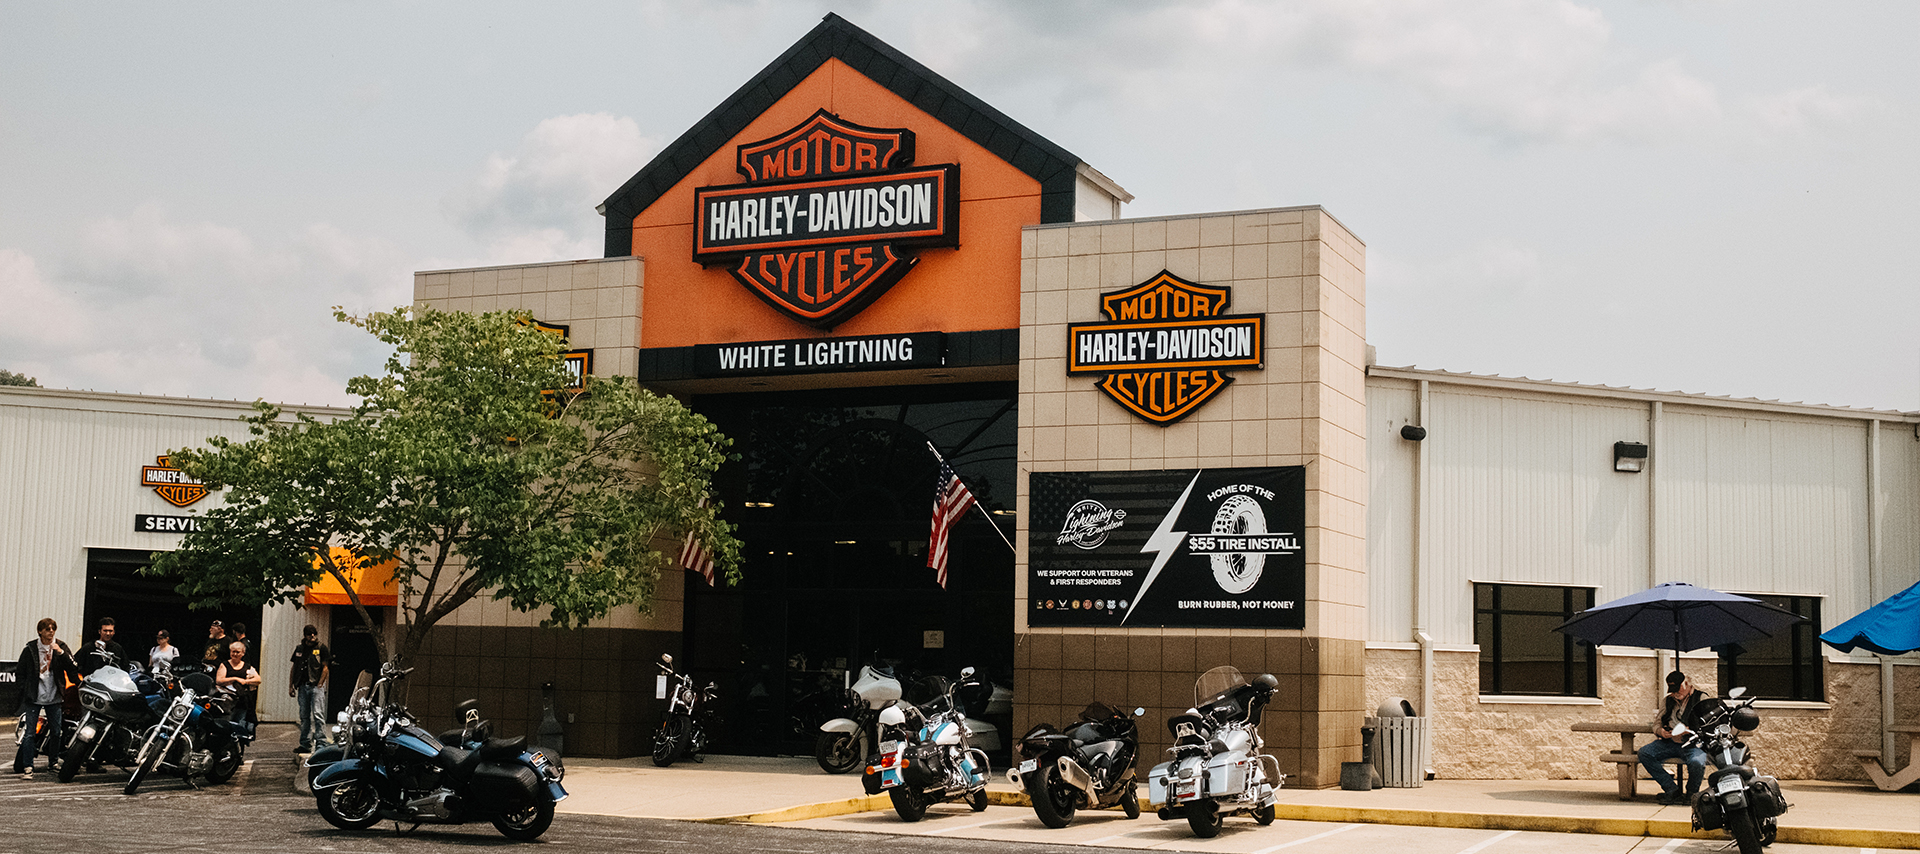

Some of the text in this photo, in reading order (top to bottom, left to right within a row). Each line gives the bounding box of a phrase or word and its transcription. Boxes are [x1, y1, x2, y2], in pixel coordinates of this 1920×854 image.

[763, 129, 877, 180] MOTOR
[710, 183, 931, 241] HARLEY-DAVIDSON
[759, 246, 873, 304] CYCLES
[1120, 283, 1210, 321] MOTOR
[718, 337, 913, 370] WHITE LIGHTNING
[1079, 326, 1251, 363] HARLEY-DAVIDSON
[1117, 370, 1208, 414] CYCLES
[162, 486, 200, 502] CYCLES
[1207, 484, 1276, 502] HOME OF THE
[1060, 508, 1112, 534] Lightning
[1076, 505, 1099, 513] WHITE
[1056, 520, 1124, 546] Harley-Davidson
[1188, 536, 1301, 552] $55 TIRE INSTALL
[1178, 600, 1295, 610] BURN RUBBER, NOT MONEY
